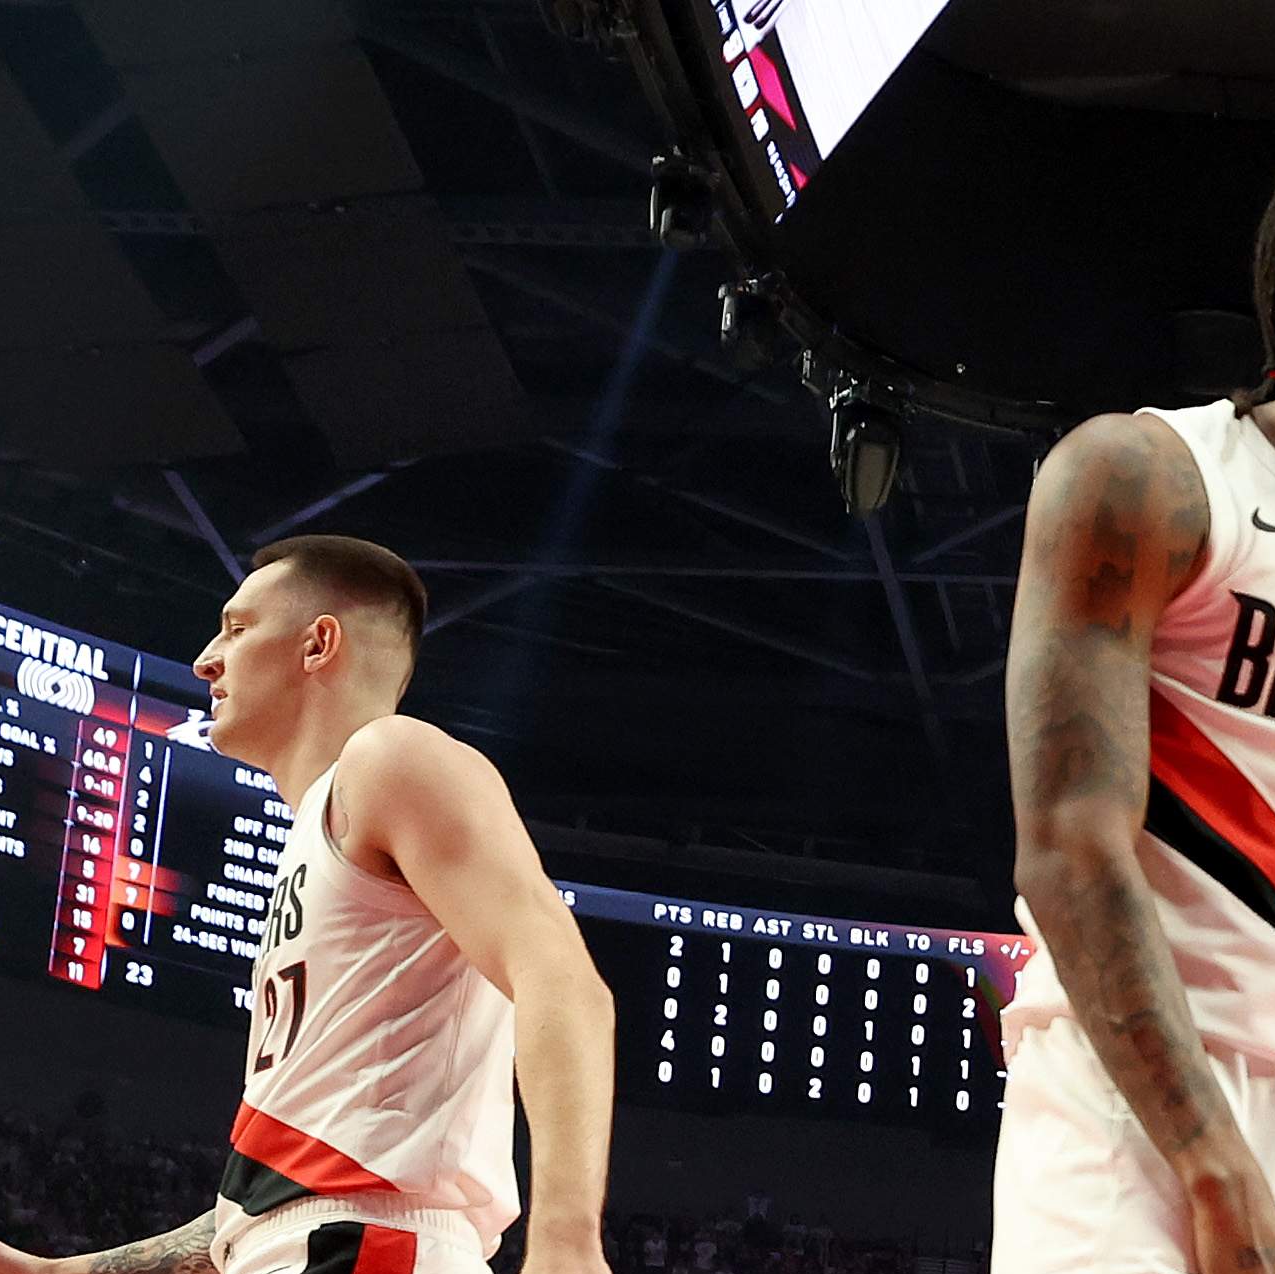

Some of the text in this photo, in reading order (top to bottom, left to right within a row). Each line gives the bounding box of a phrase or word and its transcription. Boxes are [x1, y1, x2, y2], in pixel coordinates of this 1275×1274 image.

[0, 723, 39, 749] GOAL
[235, 817, 263, 836] OFF
[224, 839, 254, 858] 2ND
[83, 860, 94, 878] 5
[76, 884, 94, 904] 31
[207, 884, 264, 910] FORCED
[73, 909, 91, 929] 15
[191, 904, 244, 930] POINTS
[173, 925, 227, 951] 24-SEC
[655, 904, 1030, 959] PTS REB AST STL BLK TO FLS +/-
[74, 938, 85, 955] 7
[69, 962, 83, 981] 11
[670, 936, 974, 987] 2 1 0 0 0 0 1
[126, 962, 152, 985] 23
[253, 960, 308, 1074] 27
